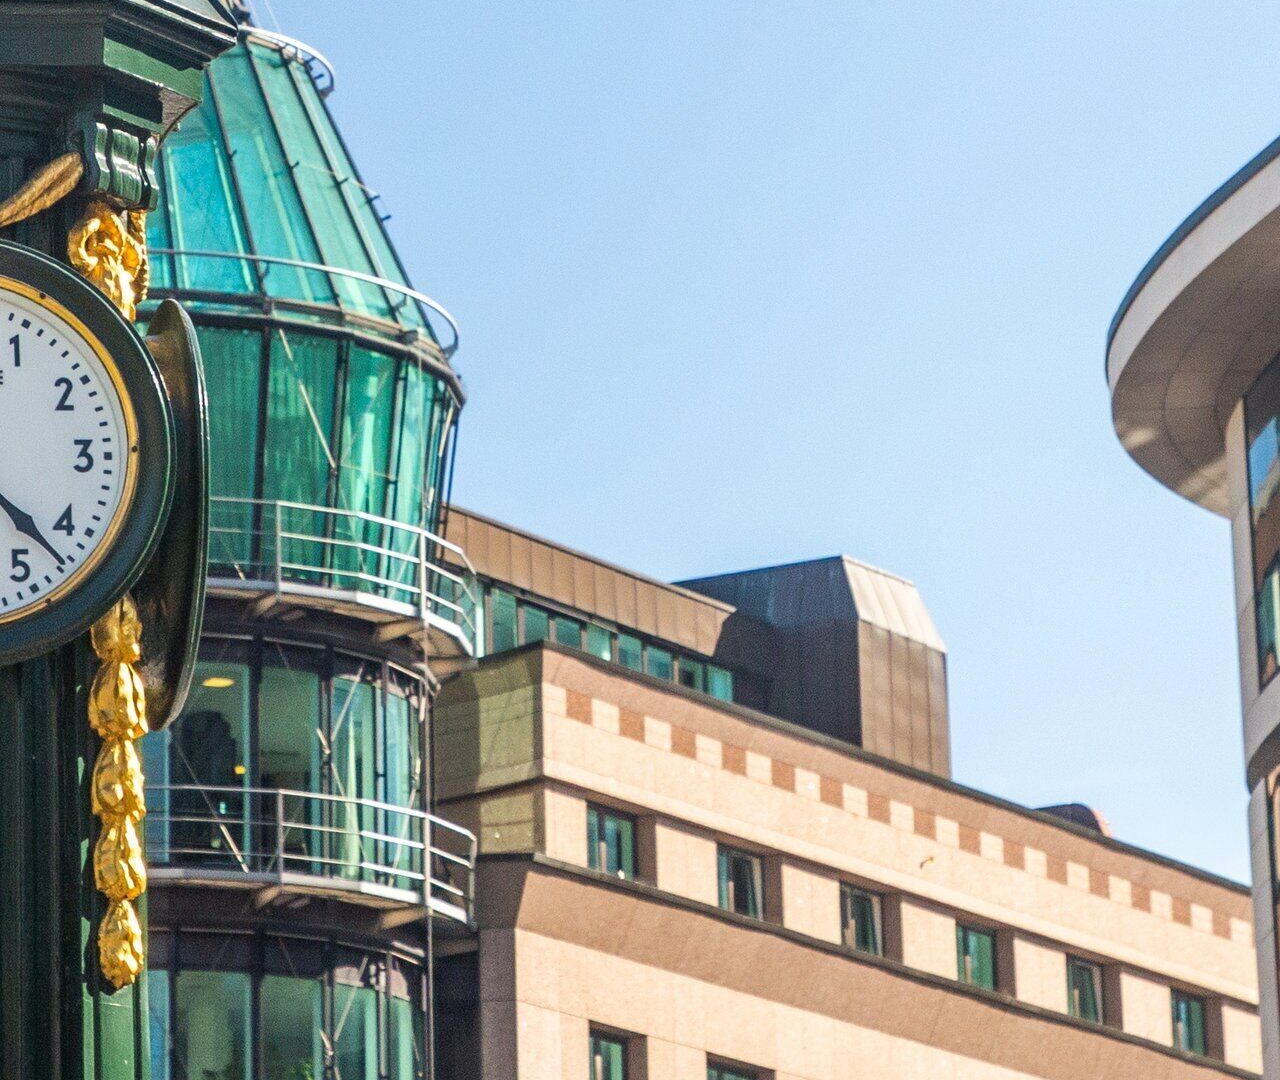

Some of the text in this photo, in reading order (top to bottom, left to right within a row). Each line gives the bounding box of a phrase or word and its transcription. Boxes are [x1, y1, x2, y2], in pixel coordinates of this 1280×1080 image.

[10, 335, 20, 366] 1
[55, 378, 74, 410] 2
[74, 440, 93, 472] 3
[53, 504, 75, 536] 4
[10, 549, 30, 582] 5
